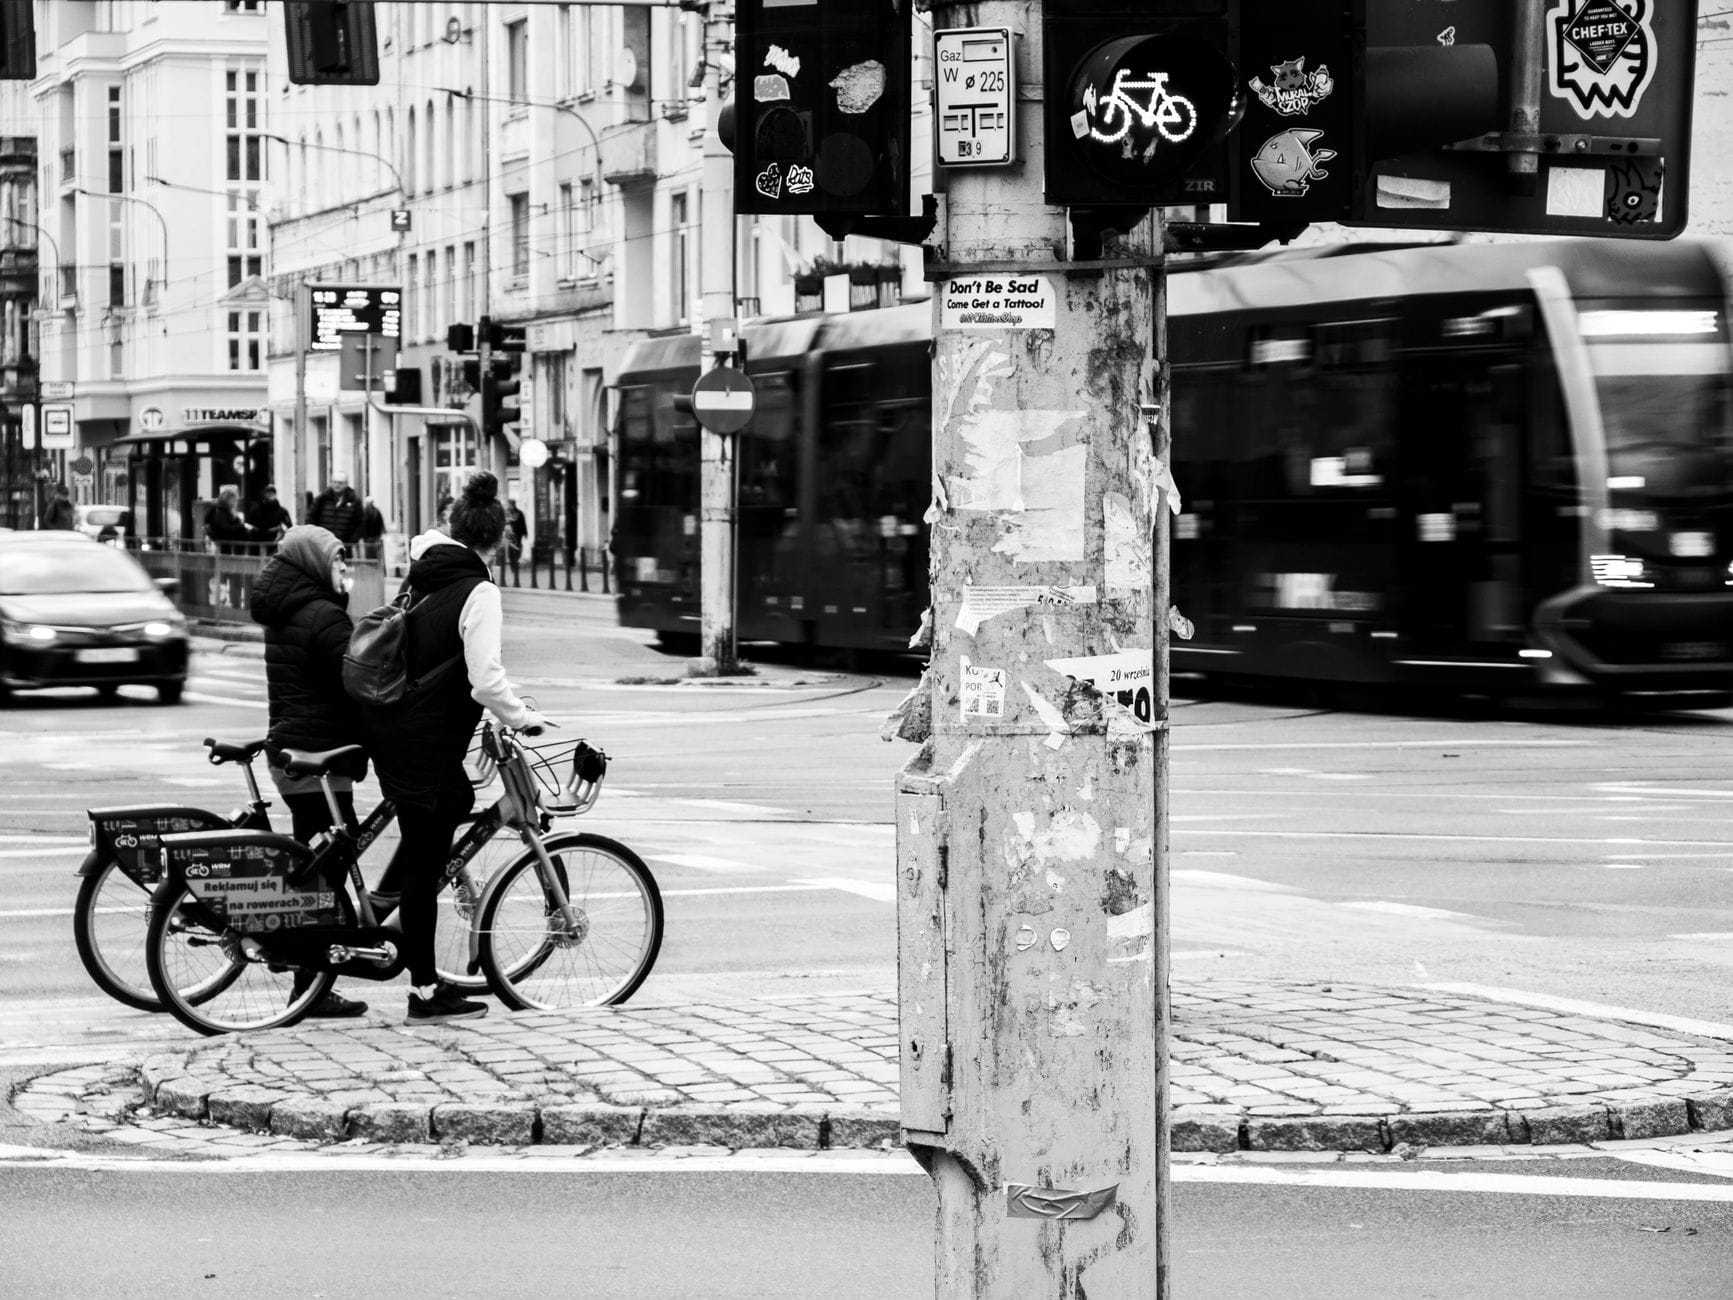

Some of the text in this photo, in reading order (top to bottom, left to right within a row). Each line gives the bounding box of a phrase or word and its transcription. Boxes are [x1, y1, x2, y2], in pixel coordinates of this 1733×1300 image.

[940, 49, 962, 62] Gaz
[943, 67, 959, 83] W
[980, 71, 1005, 93] 225
[1274, 87, 1312, 103] MURAL
[1278, 97, 1309, 113] SZOP
[950, 279, 1039, 294] Don't Be Sad
[947, 298, 1045, 309] Come Get a Tattoo!
[1110, 669, 1121, 682] 20
[204, 879, 277, 893] Reklamuj się
[229, 897, 299, 910] na rowerach
